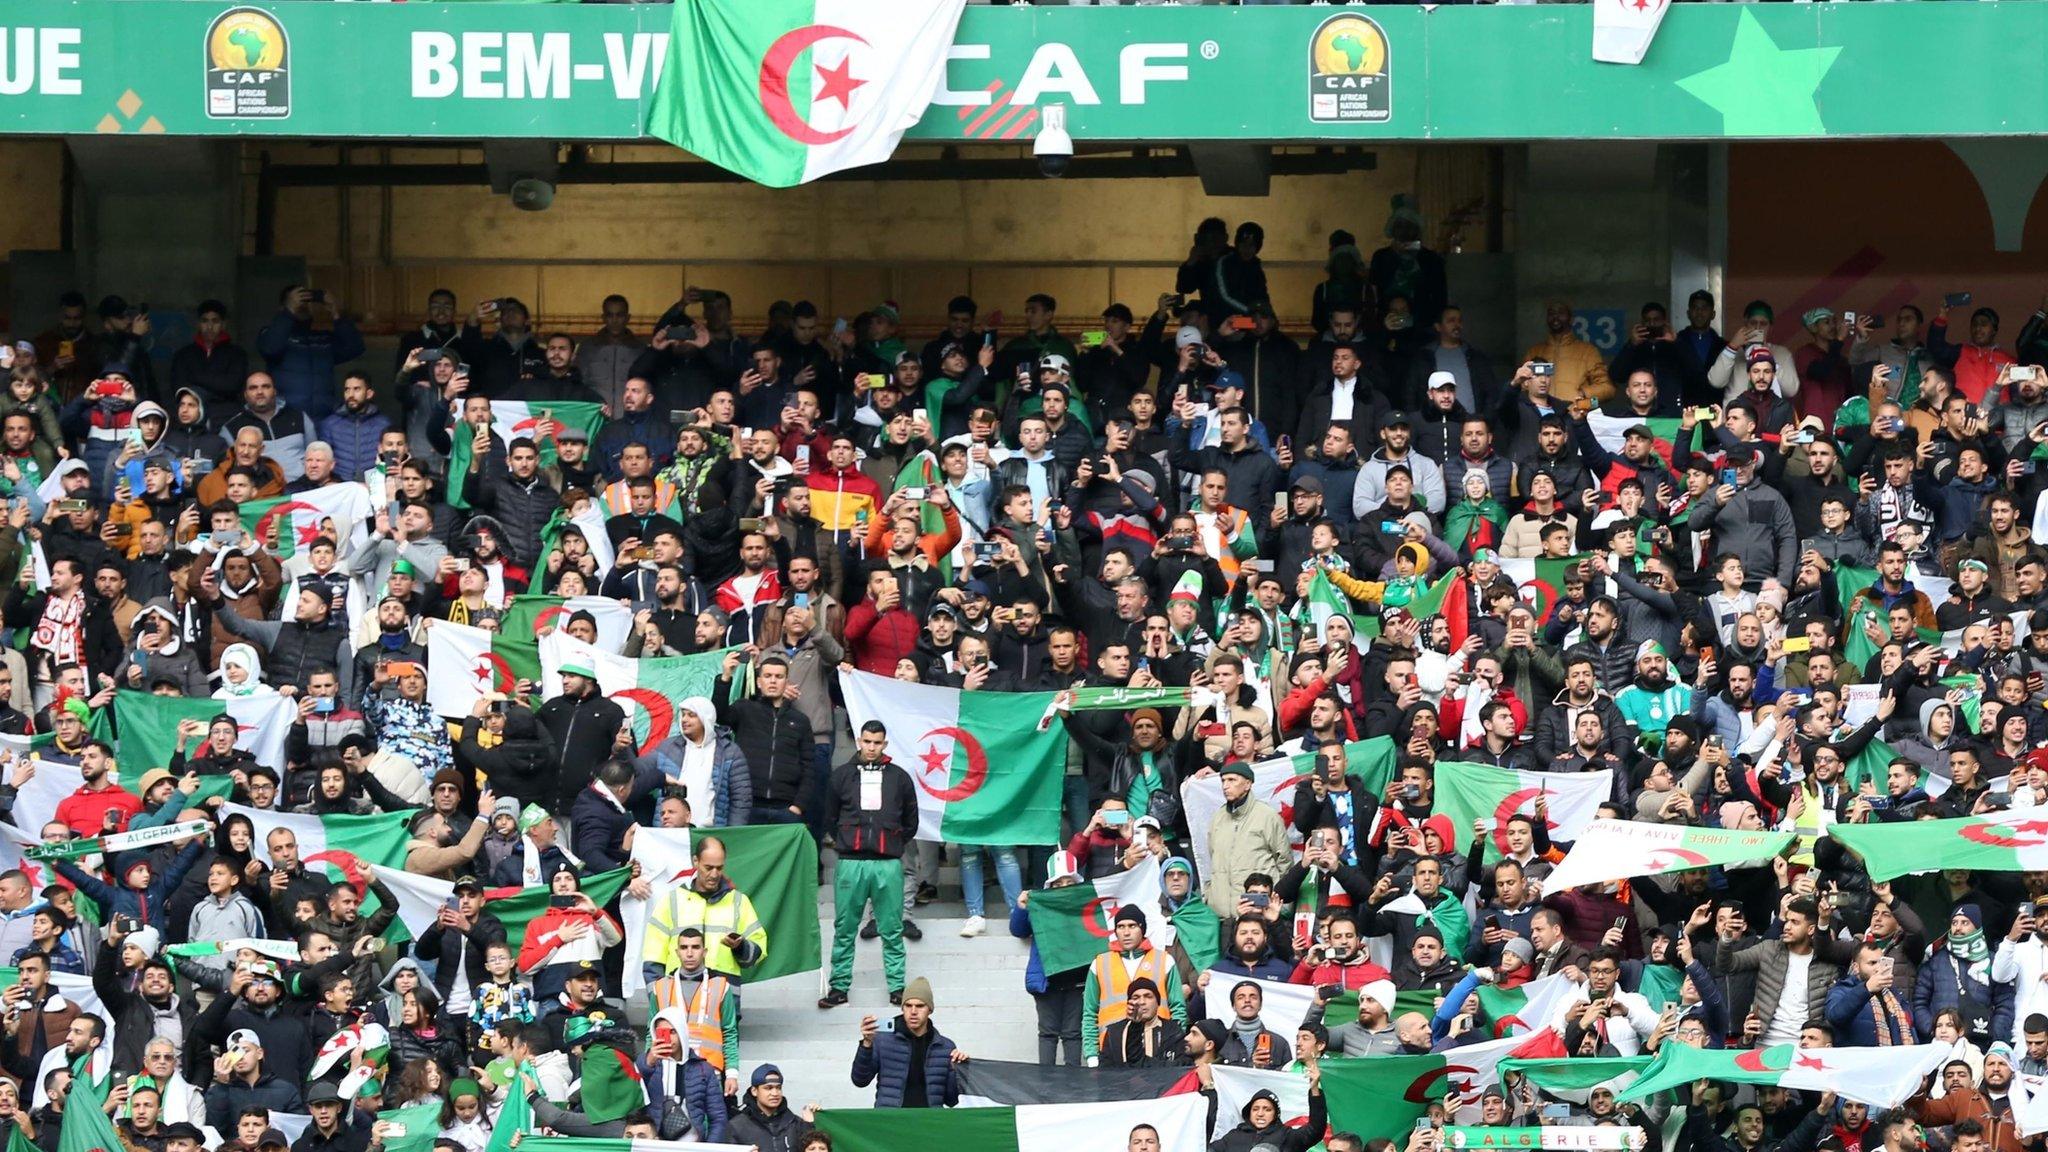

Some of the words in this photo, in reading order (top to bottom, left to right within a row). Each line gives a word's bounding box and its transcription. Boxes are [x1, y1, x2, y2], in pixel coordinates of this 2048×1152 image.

[223, 72, 272, 84] CAF
[1326, 77, 1373, 88] CAF
[1340, 110, 1389, 118] CHAMPIONSHIP
[1572, 316, 1617, 349] 33
[1094, 688, 1167, 705] الجزائر
[127, 827, 182, 843] ALGERIA
[1484, 1134, 1598, 1146] ALGERIE
